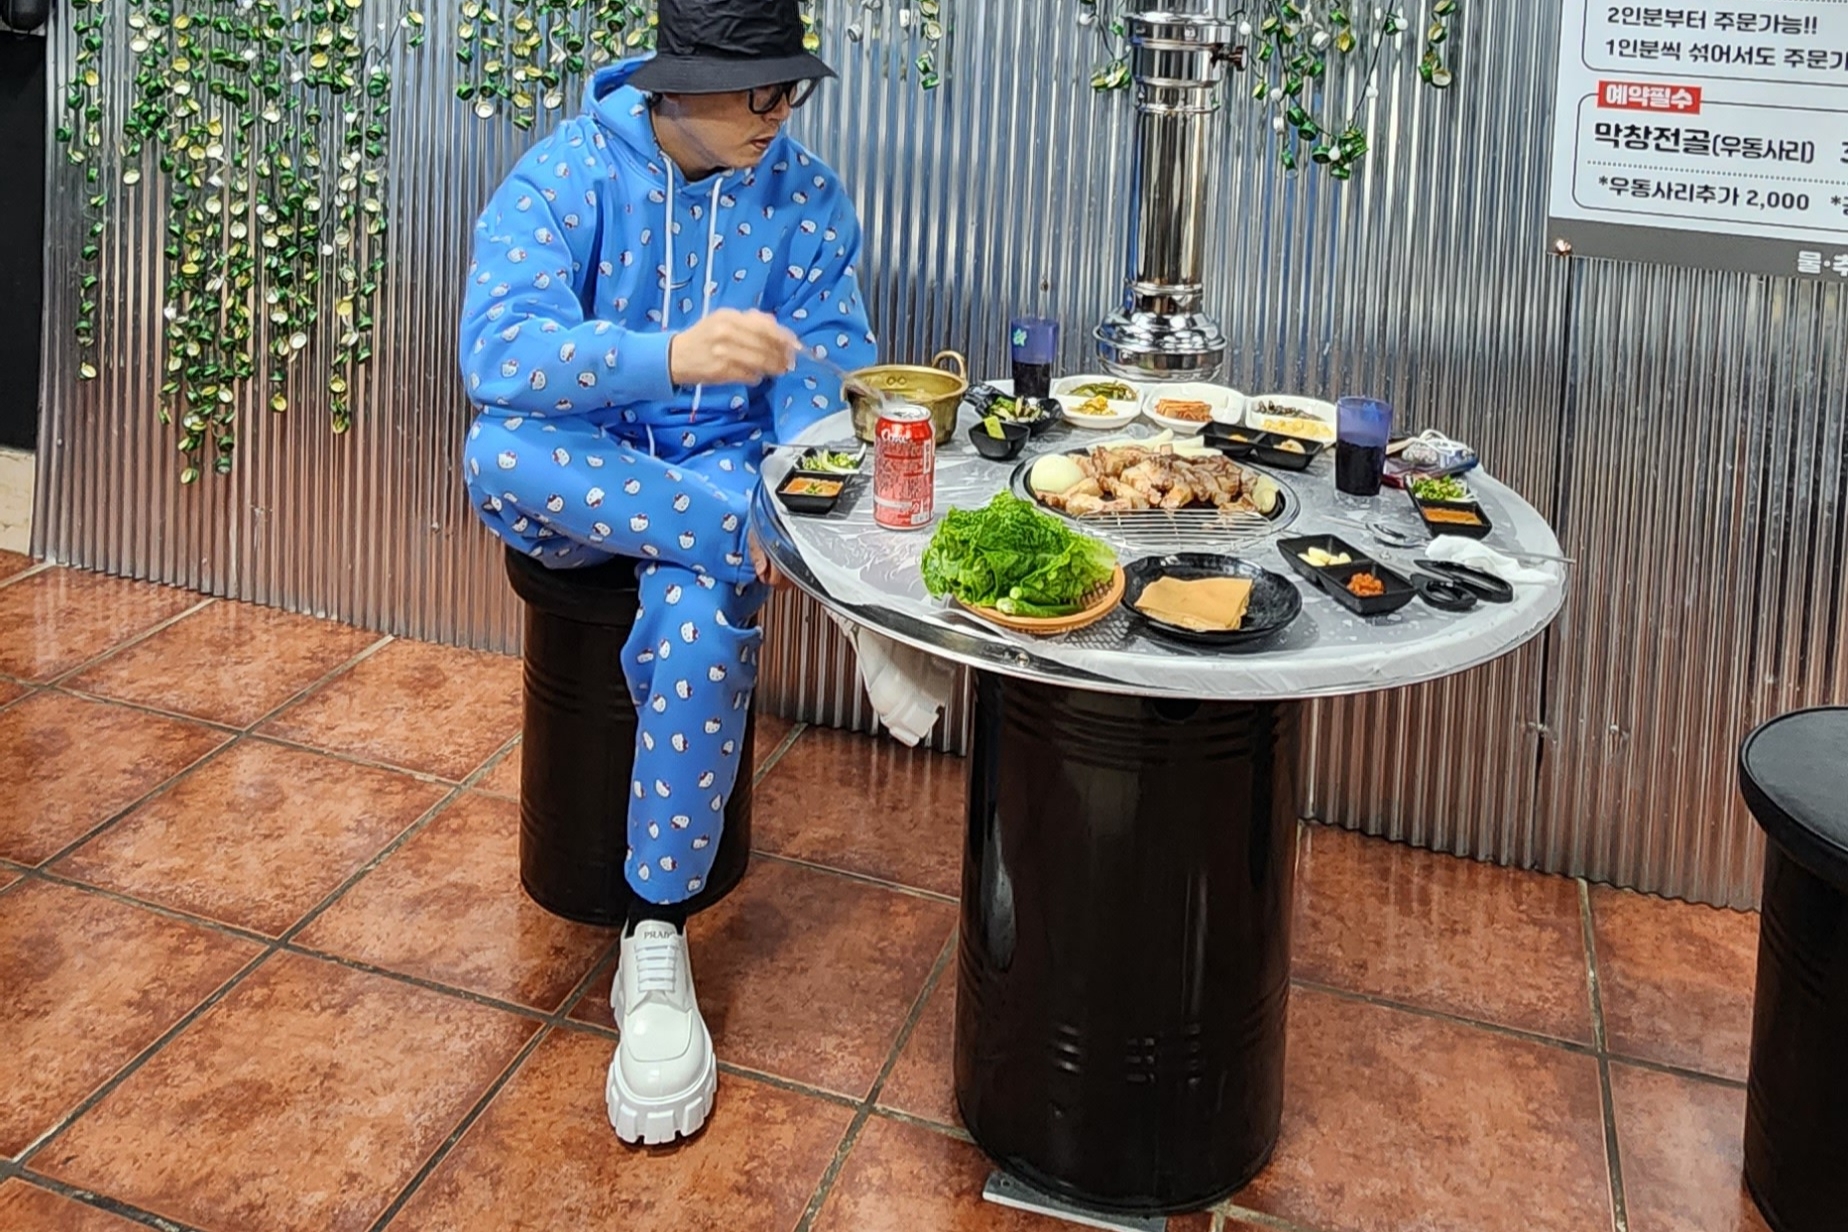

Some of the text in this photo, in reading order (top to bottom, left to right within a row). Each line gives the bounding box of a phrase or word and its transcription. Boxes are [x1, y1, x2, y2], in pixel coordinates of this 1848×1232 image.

[1607, 6, 1818, 35] 2인분부터 주문가능!!
[1605, 38, 1681, 61] 1인분씩
[1688, 42, 1776, 67] 섞어서도
[1606, 84, 1693, 110] 예약필수
[1594, 122, 1815, 164] 막창전골(우동사리)
[1746, 189, 1810, 211] 2,000
